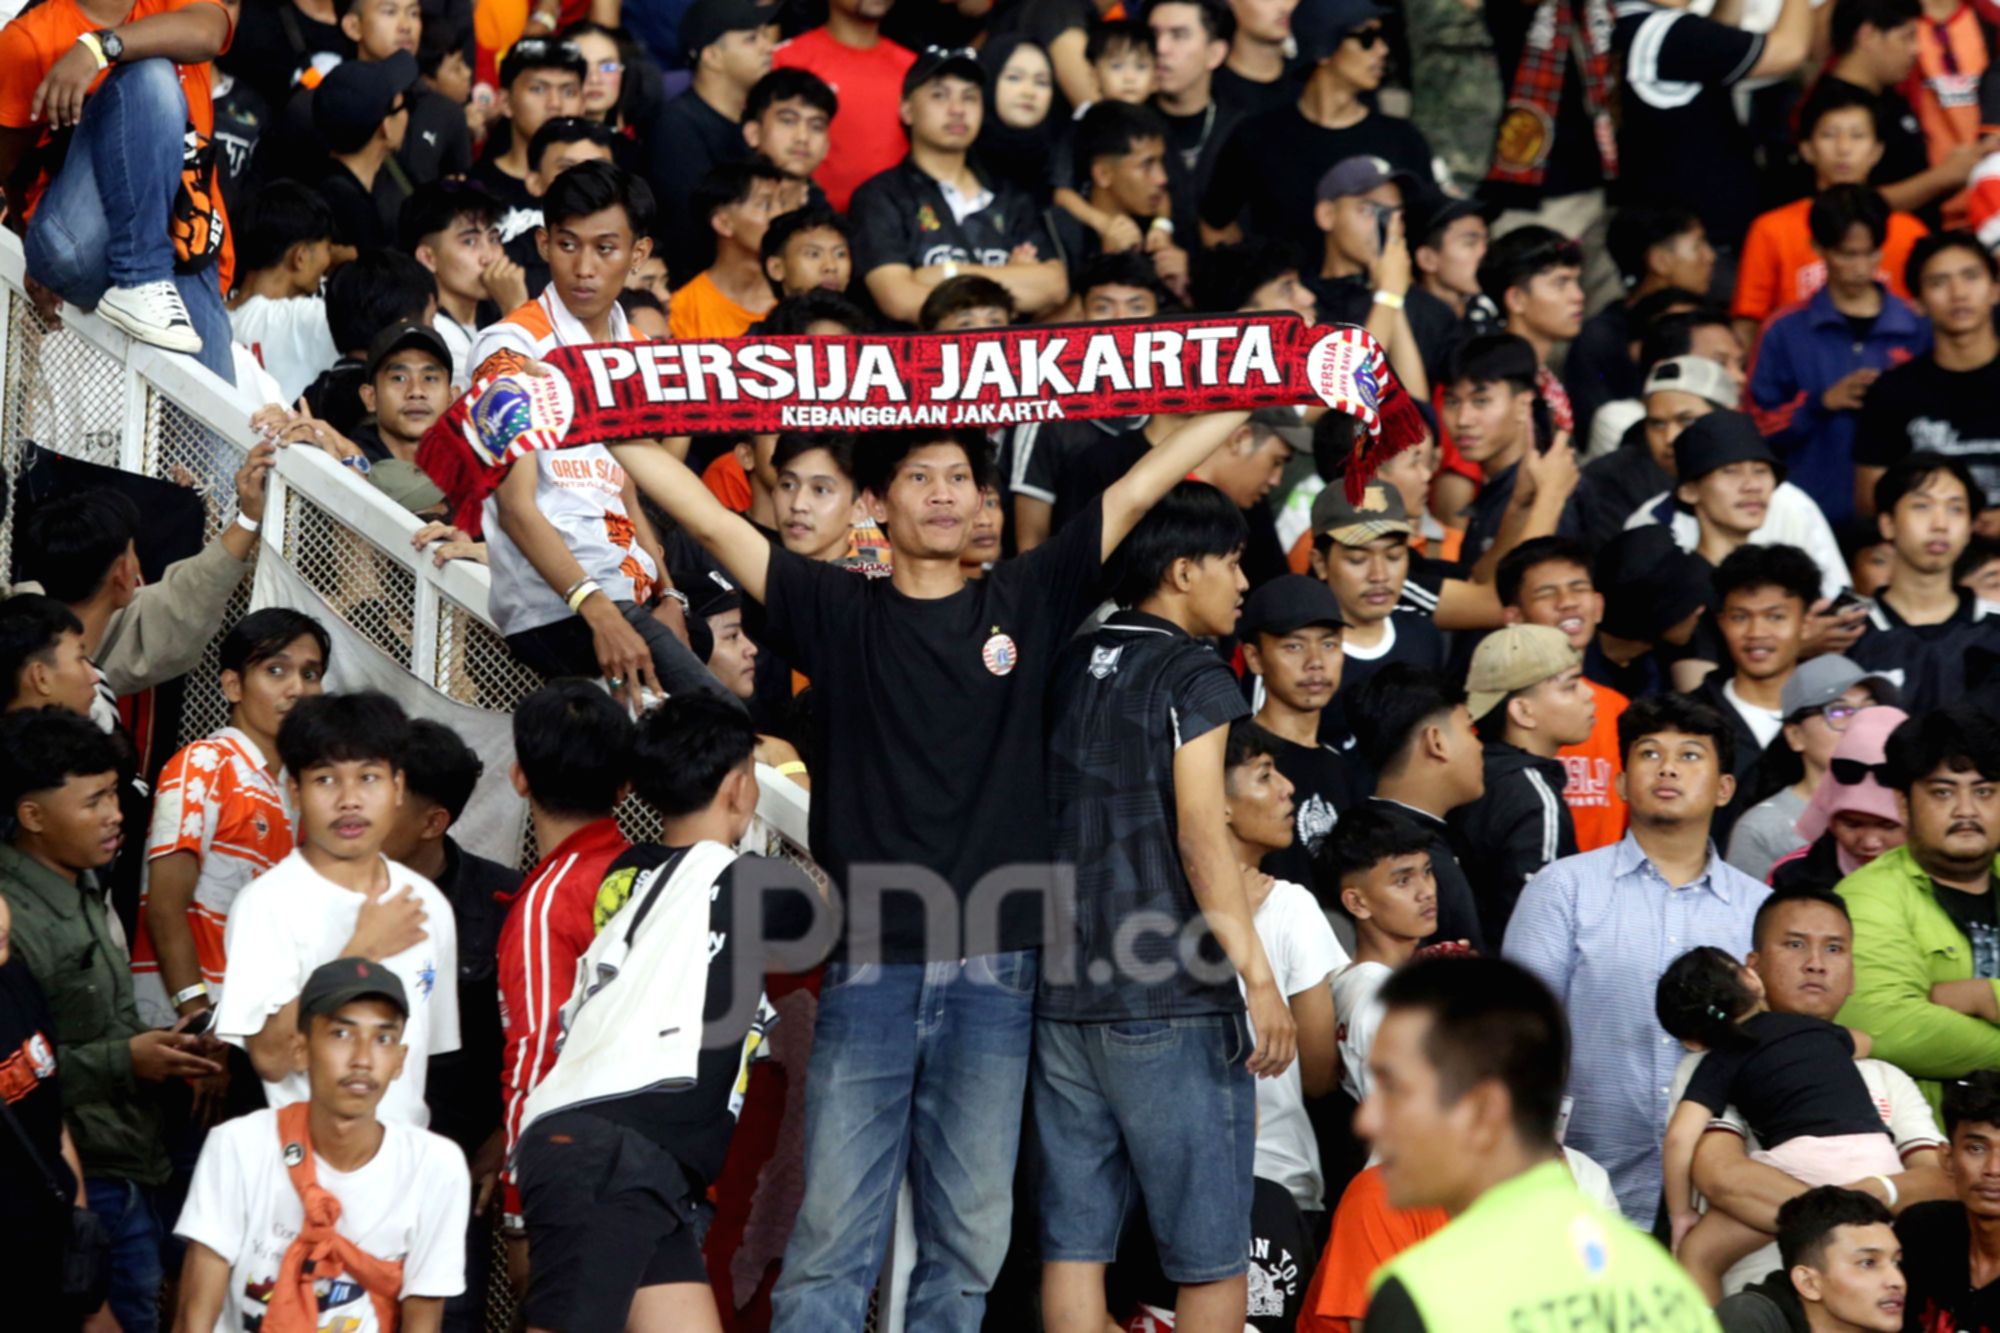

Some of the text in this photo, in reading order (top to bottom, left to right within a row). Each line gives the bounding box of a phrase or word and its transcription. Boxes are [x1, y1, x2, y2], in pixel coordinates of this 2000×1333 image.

[582, 325, 1282, 407] PERSIJA JAKARTA
[1321, 341, 1338, 397] PERSIJA
[781, 400, 1065, 426] KEBANGGAAN JAKARTA
[551, 459, 592, 479] OREN
